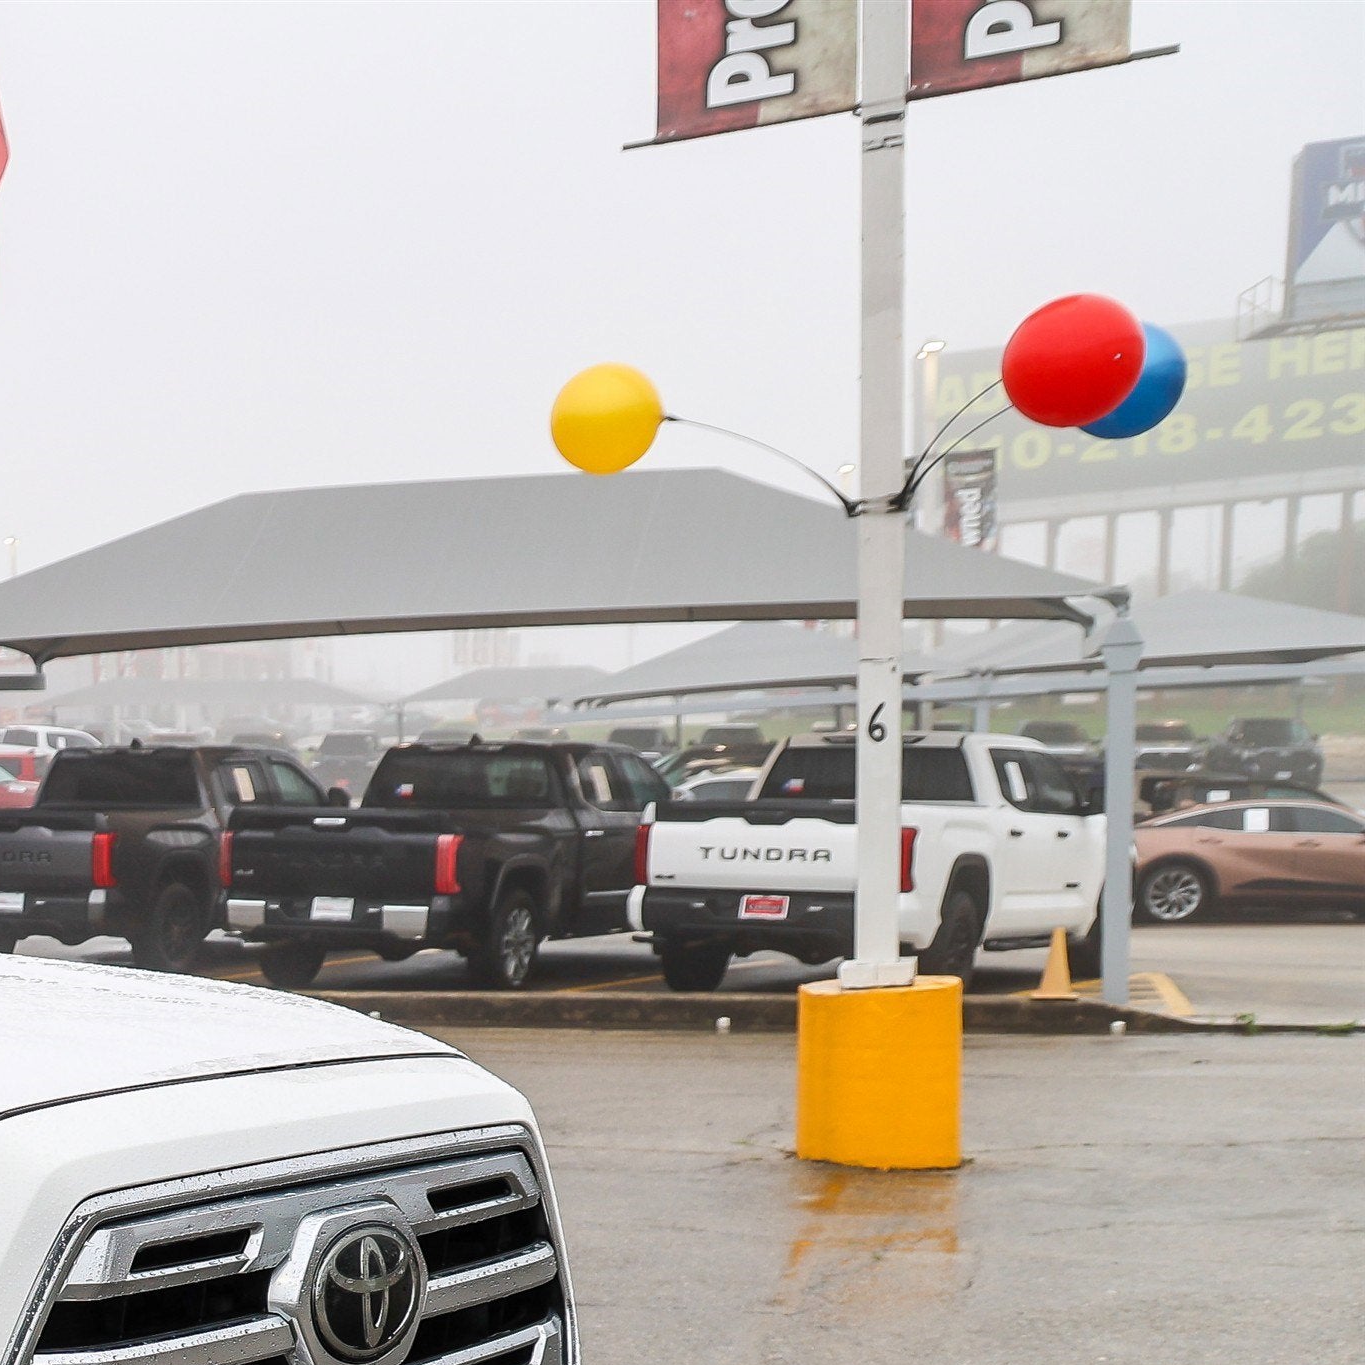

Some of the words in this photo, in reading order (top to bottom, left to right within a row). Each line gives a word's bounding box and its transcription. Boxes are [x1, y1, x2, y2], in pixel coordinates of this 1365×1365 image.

[963, 0, 1061, 60] P
[868, 700, 887, 743] 6
[699, 846, 833, 863] TUNDRA
